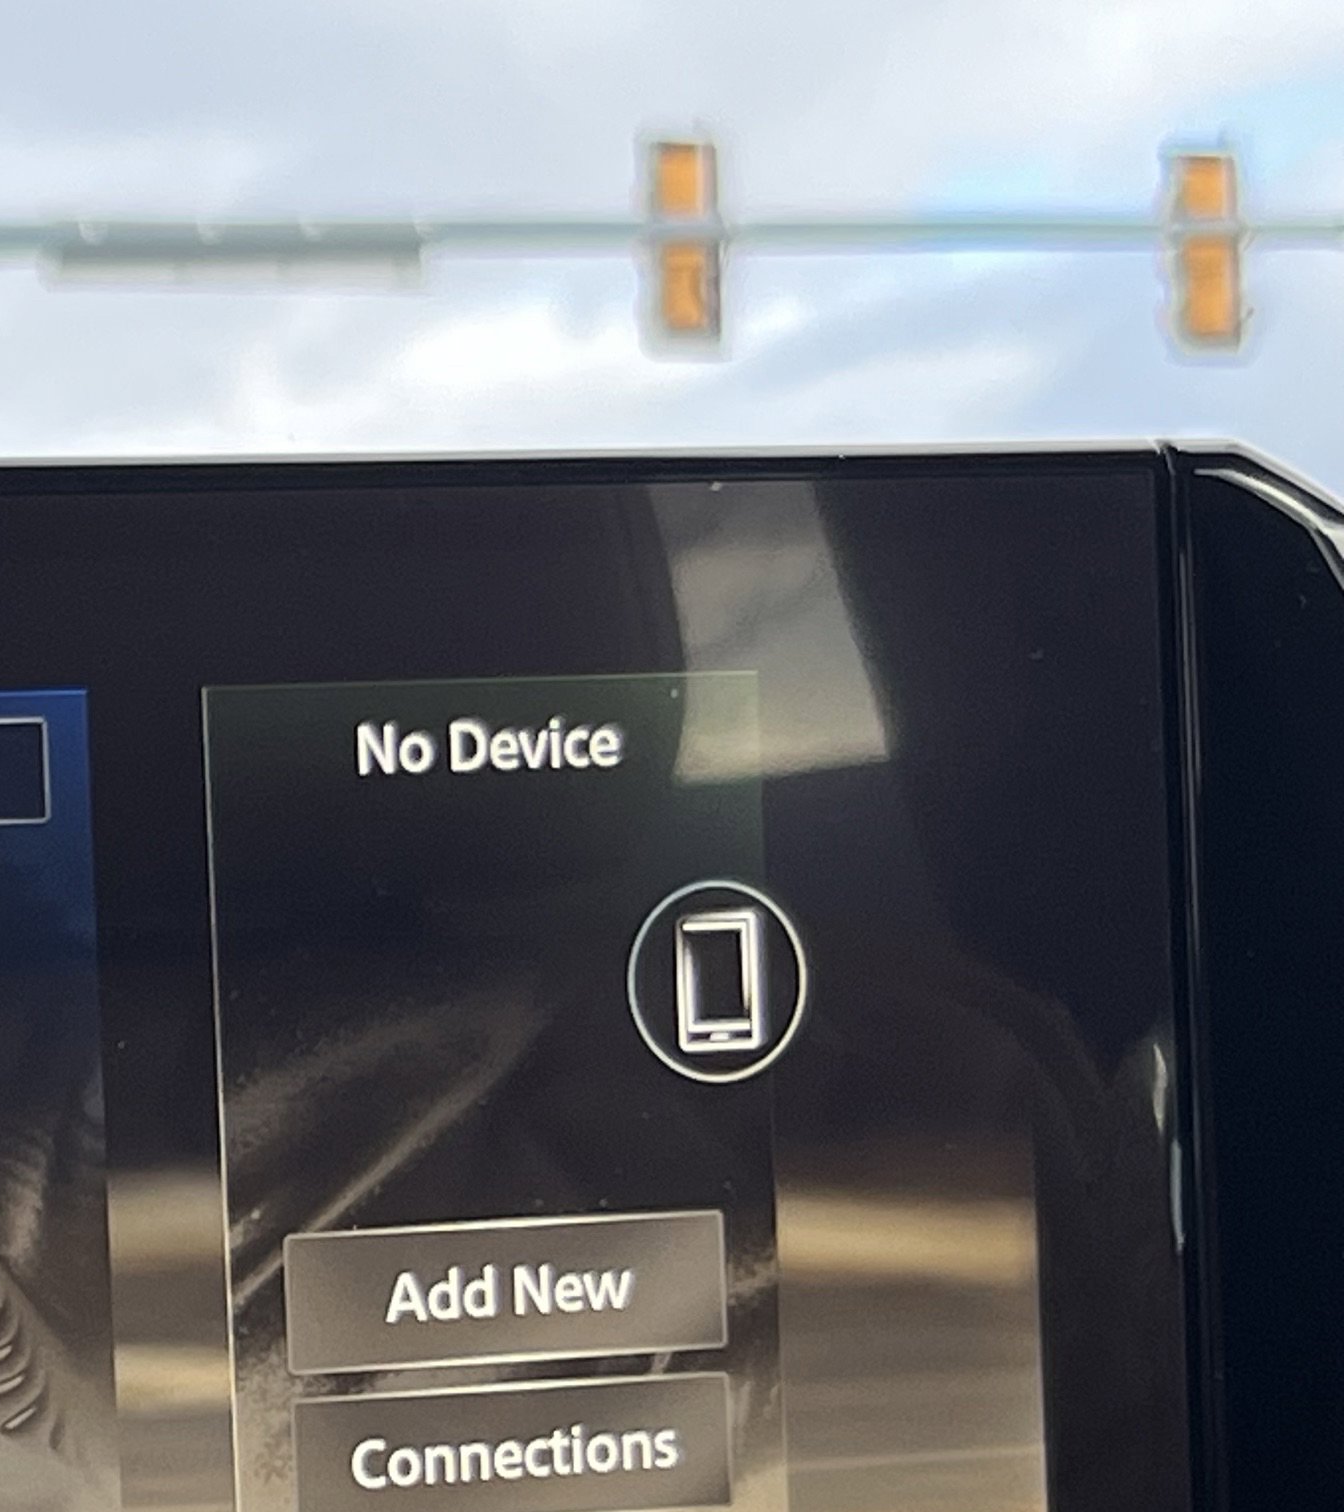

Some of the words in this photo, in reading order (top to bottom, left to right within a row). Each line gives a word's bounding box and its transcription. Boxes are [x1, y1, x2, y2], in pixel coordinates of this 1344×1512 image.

[356, 722, 433, 776] No
[449, 717, 622, 773] Device
[384, 1264, 498, 1324] Add
[513, 1263, 634, 1316] New
[351, 1426, 681, 1490] Connections
